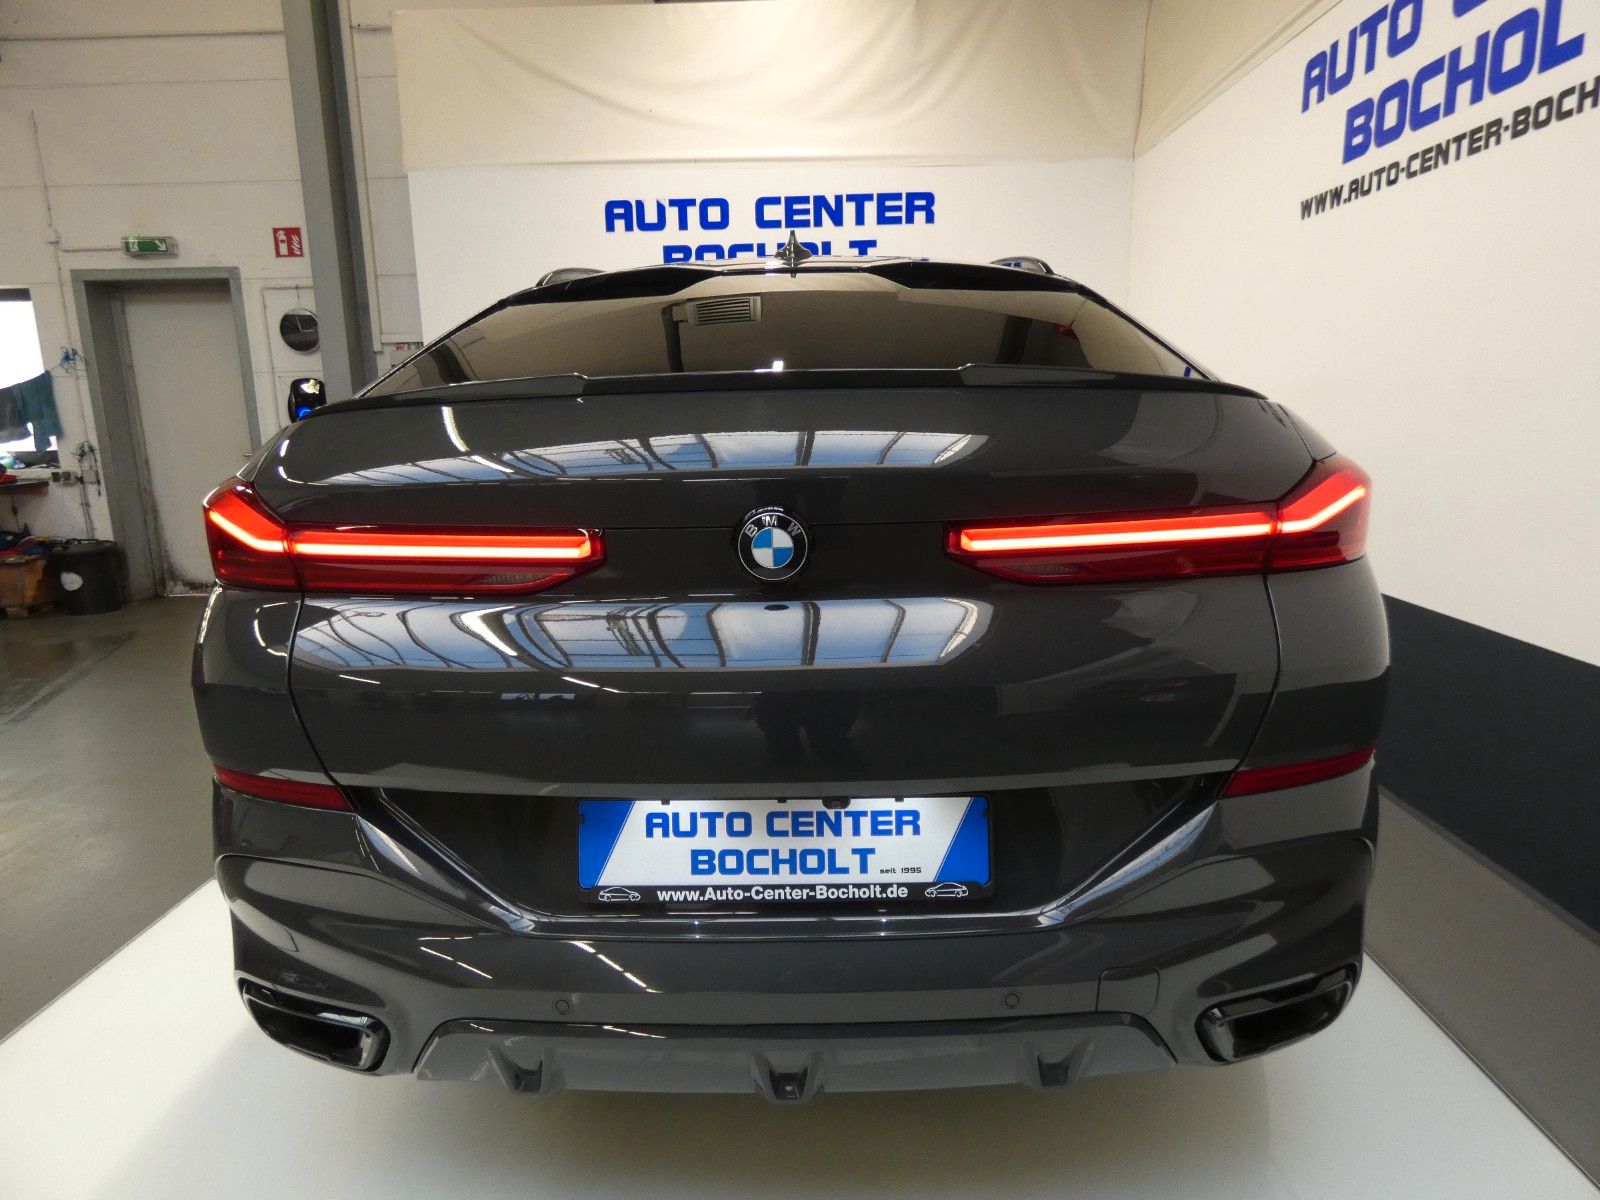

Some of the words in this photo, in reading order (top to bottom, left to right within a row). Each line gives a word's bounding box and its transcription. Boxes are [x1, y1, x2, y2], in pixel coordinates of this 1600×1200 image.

[1301, 0, 1423, 114] AUTO
[604, 198, 730, 233] AUTO
[754, 191, 936, 230] CENTER
[744, 515, 801, 538] BMW
[645, 810, 752, 839] AUTO
[766, 808, 921, 838] CENTER
[690, 847, 876, 876] BOCHOLT
[900, 866, 922, 874] 1995
[656, 884, 909, 902] www.Auto-Center-Bocholt.de
